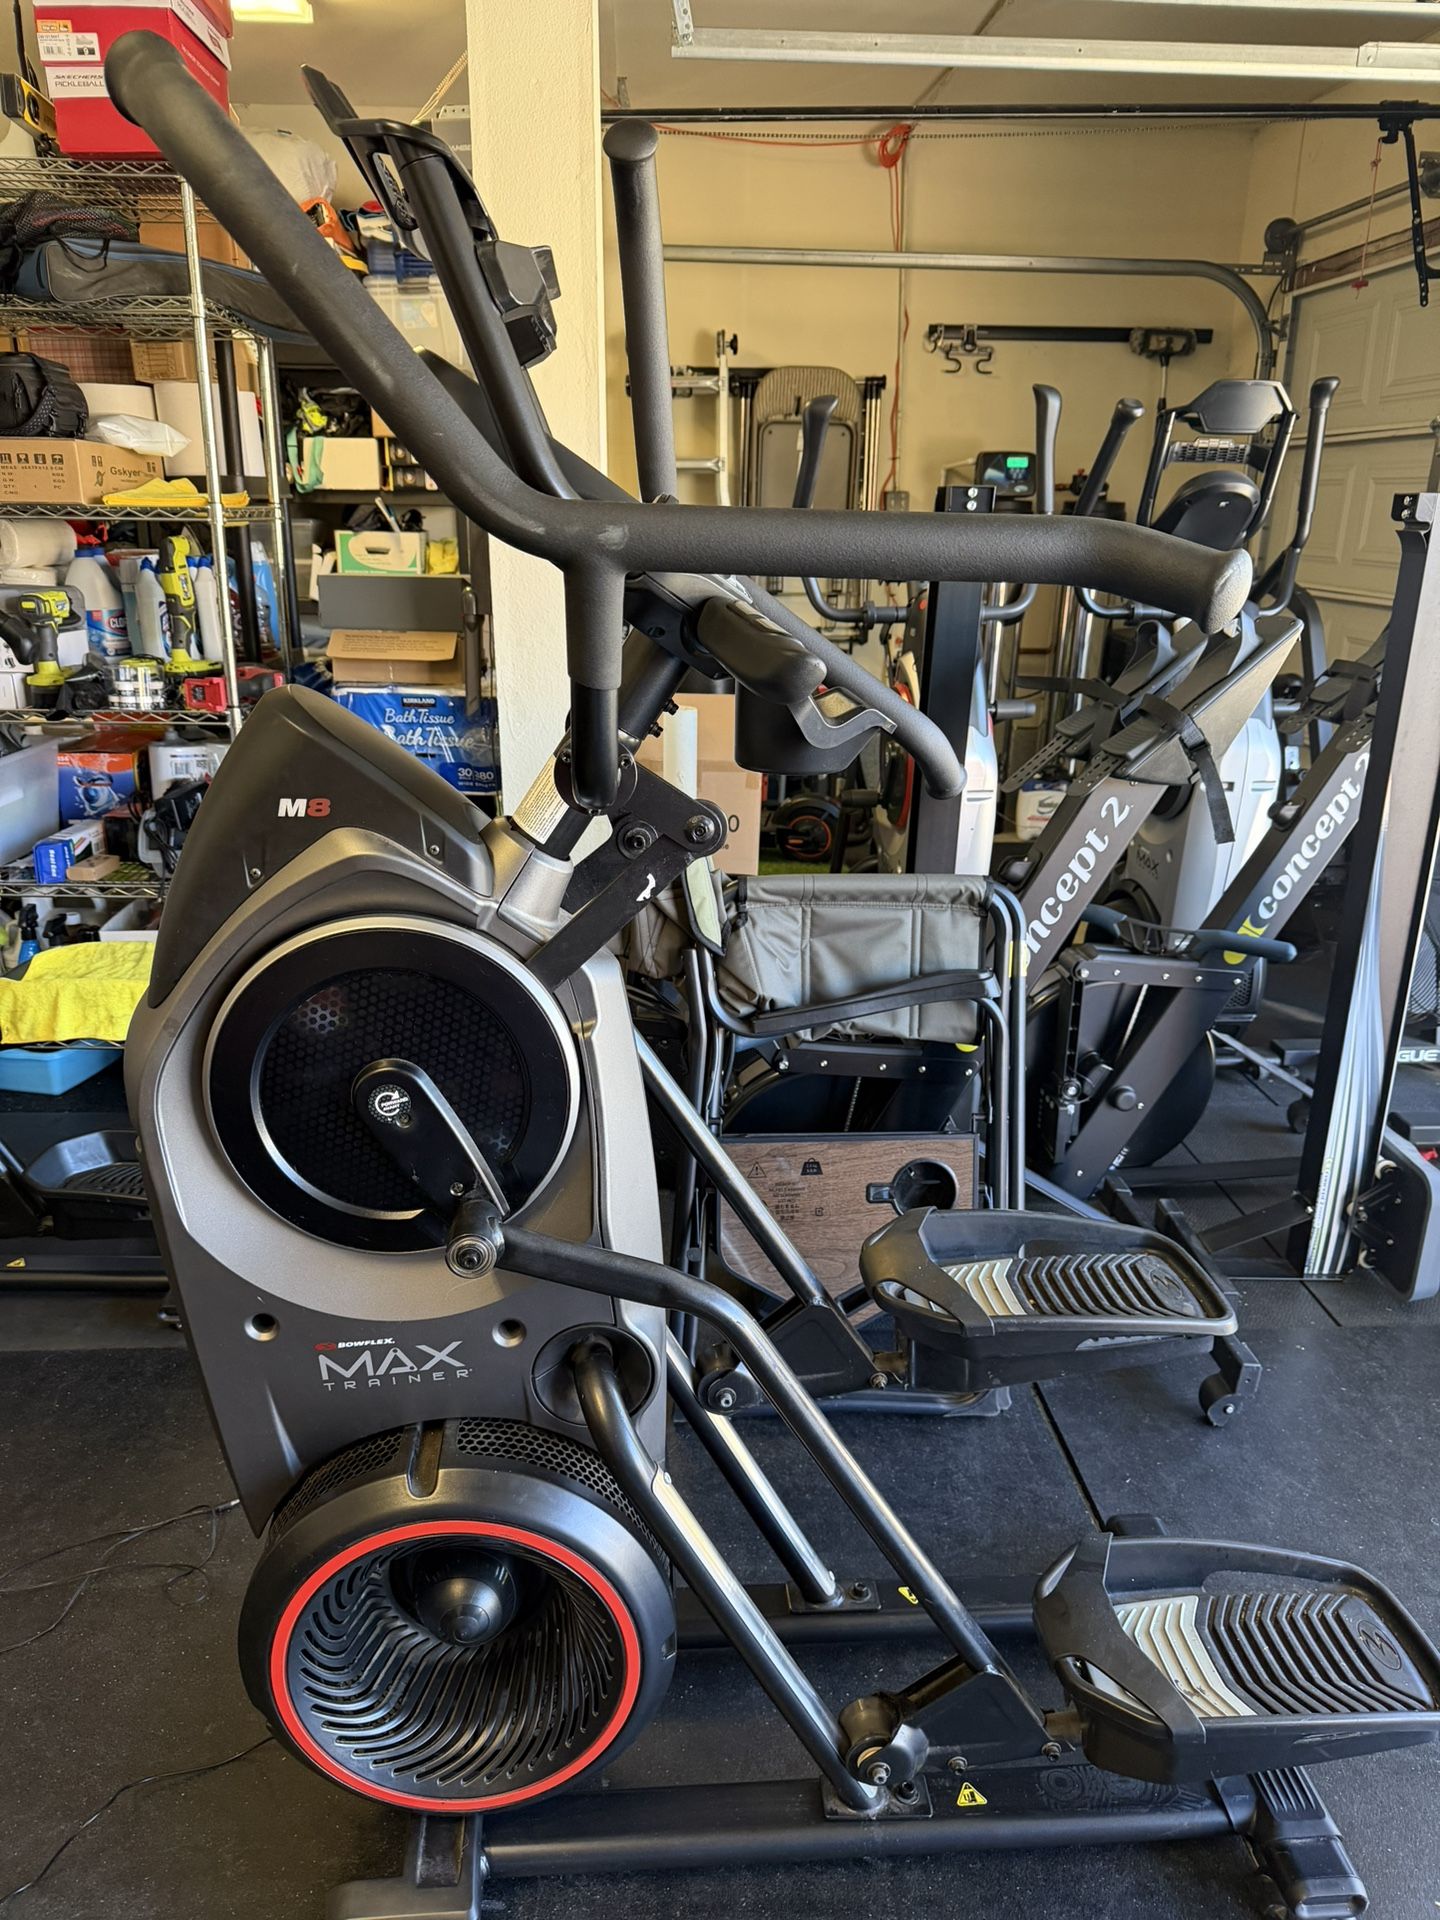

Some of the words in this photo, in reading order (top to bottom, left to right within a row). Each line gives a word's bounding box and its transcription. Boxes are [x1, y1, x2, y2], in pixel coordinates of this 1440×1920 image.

[110, 466, 140, 478] Gskyer
[385, 707, 418, 724] Bath
[418, 708, 455, 724] Tissue
[426, 726, 474, 748] Tissue
[458, 767, 473, 777] 30
[278, 798, 331, 817] M8
[1100, 796, 1131, 829] 2
[1258, 777, 1362, 920] concept
[318, 1340, 466, 1380] MAX
[323, 1370, 473, 1391] TRAINER
